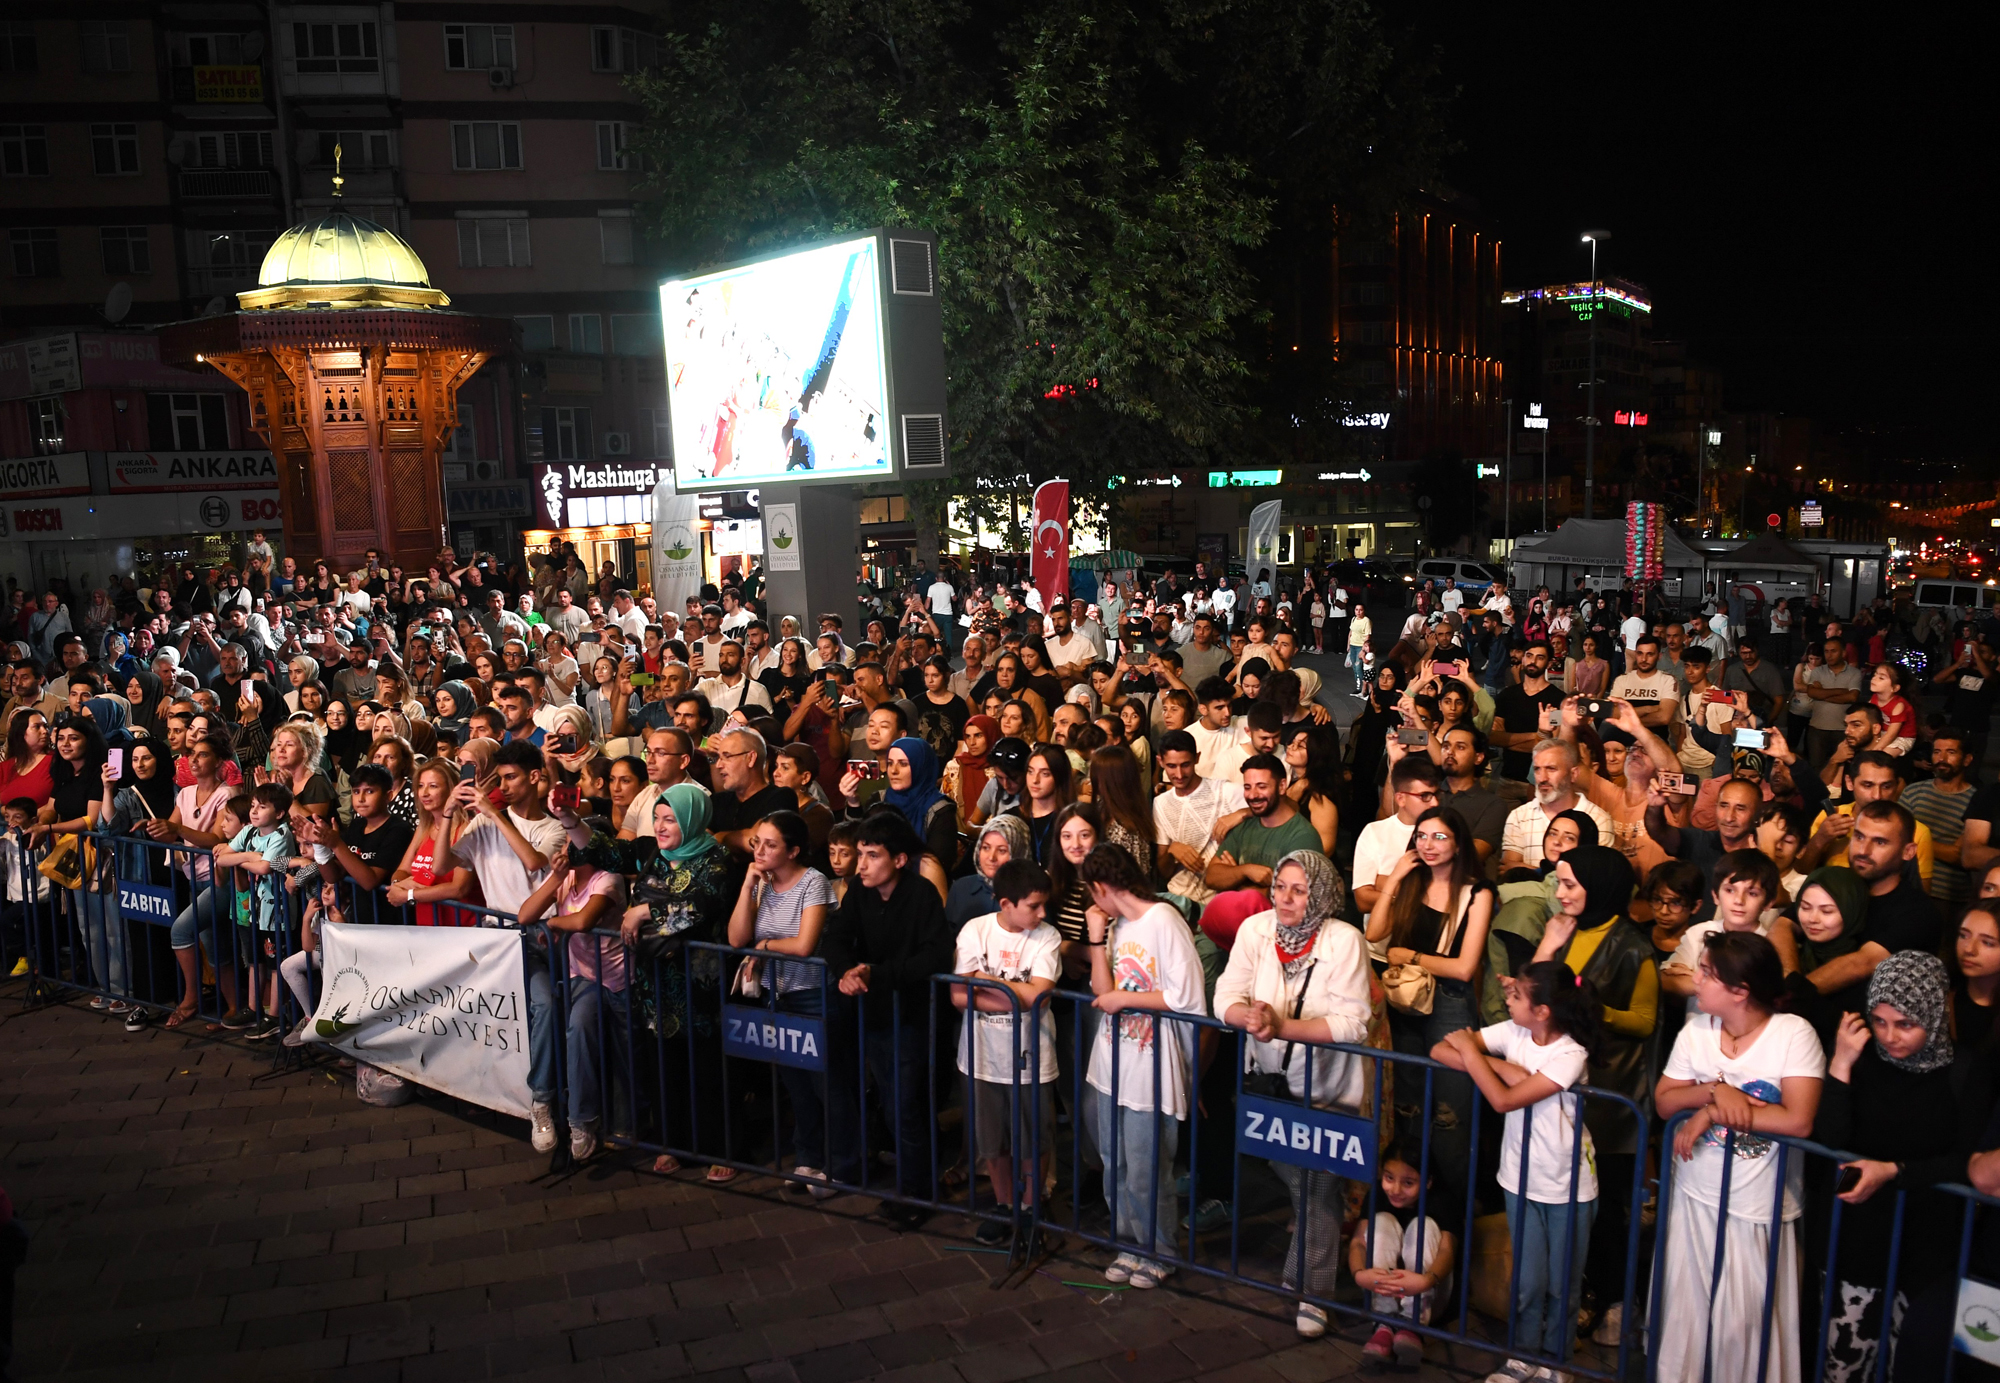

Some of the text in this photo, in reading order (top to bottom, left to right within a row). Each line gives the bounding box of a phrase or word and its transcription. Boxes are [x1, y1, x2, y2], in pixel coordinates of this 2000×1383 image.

[198, 70, 257, 85] SATILIK
[199, 88, 218, 98] 0532
[249, 88, 260, 98] 68
[1570, 302, 1604, 312] YEŞİLÇM
[1578, 312, 1593, 321] CAF
[110, 341, 156, 360] MUSA
[117, 459, 151, 467] ANKARA
[125, 466, 158, 476] SİGORTA
[168, 457, 276, 479] ANKARA
[450, 489, 524, 512] AYHAN
[13, 508, 62, 531] BOSCH
[1624, 688, 1658, 698] PARIS
[120, 890, 171, 917] ZABITA
[371, 984, 519, 1022] OSMANGAZİ
[728, 1018, 818, 1057] ZABITA
[1244, 1110, 1365, 1166] ZABITA
